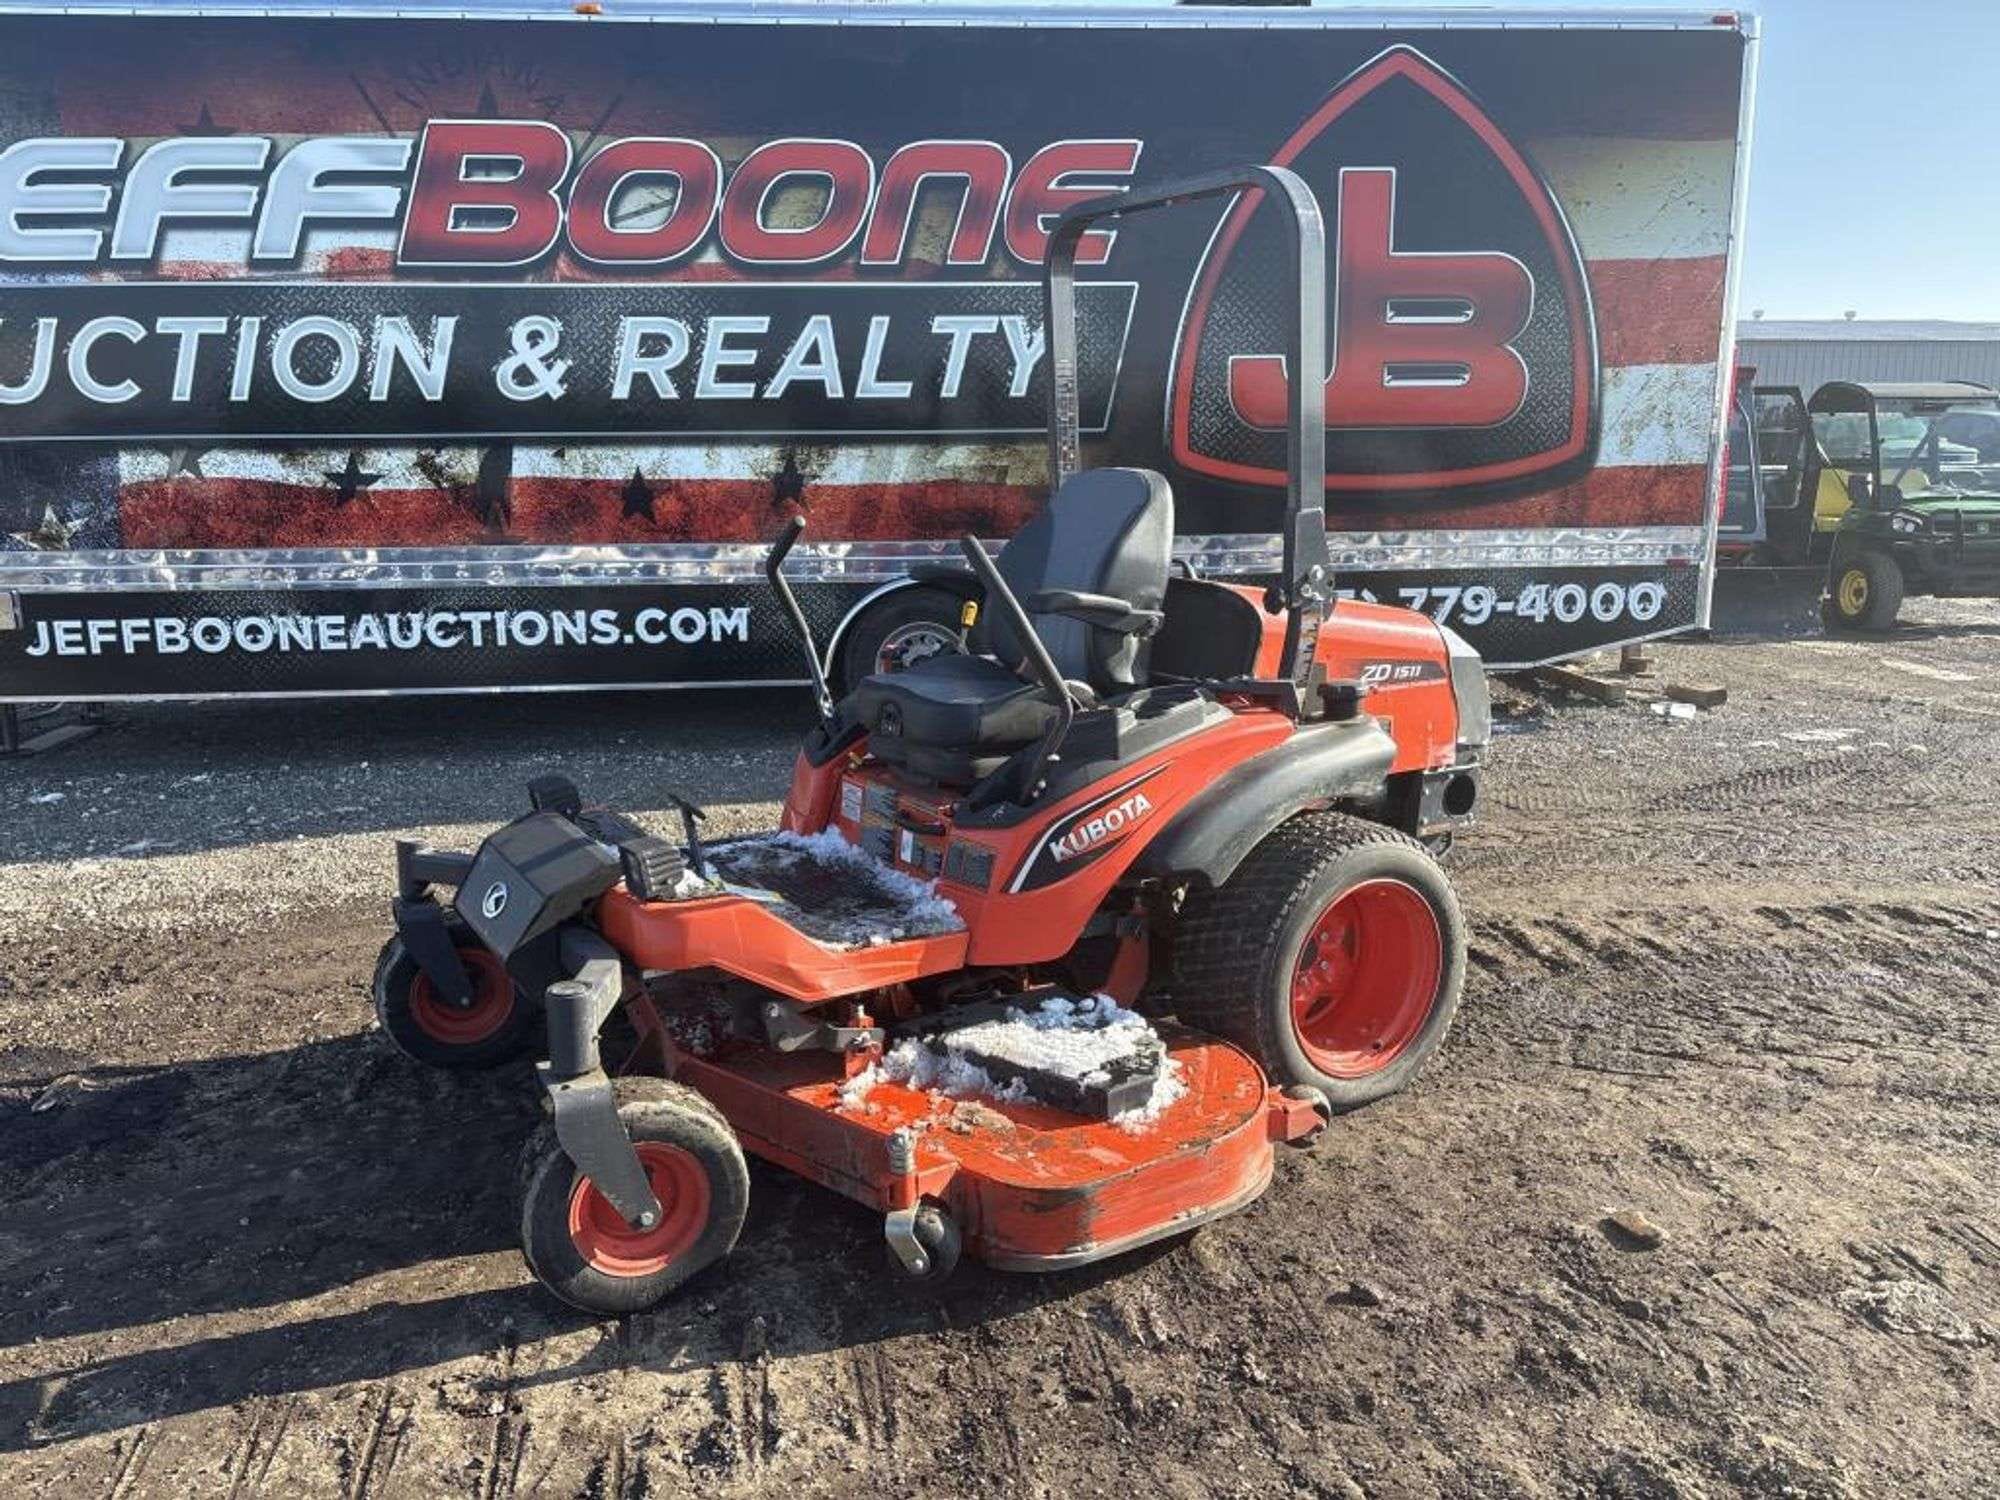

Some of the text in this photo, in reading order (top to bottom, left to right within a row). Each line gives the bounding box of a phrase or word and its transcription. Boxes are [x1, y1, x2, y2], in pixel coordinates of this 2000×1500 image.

[495, 314, 574, 401] &
[611, 315, 1046, 399] REALTY
[25, 606, 751, 656] JEFFBOONEAUCTIONS.COM
[1361, 663, 1422, 681] ZD 1511
[1049, 793, 1153, 863] KUBOTA
